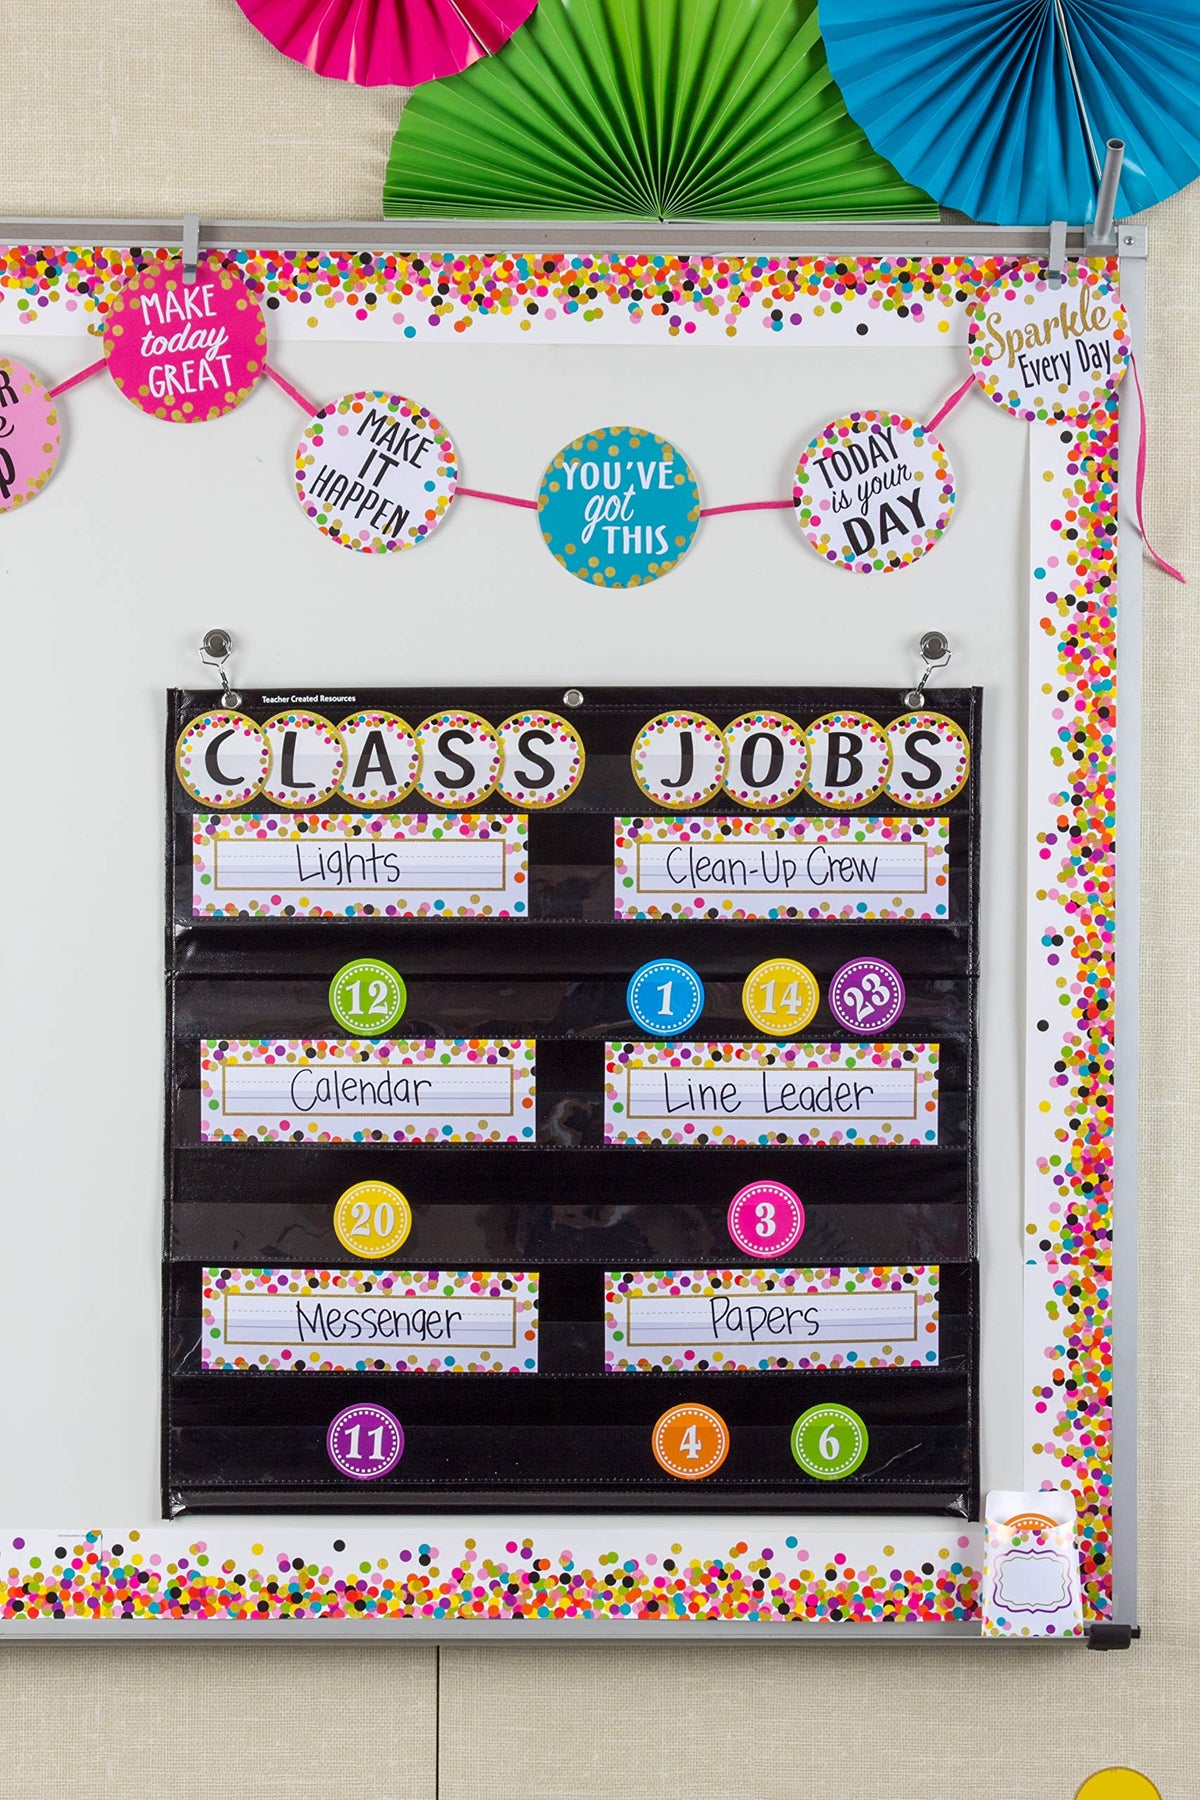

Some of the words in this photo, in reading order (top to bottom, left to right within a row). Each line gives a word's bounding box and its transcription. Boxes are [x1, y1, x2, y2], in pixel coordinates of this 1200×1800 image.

[140, 284, 217, 325] MAKE
[985, 283, 1111, 368] Sparkle
[140, 322, 228, 361] today
[148, 354, 232, 397] GREAT
[1018, 351, 1071, 388] Every
[1075, 339, 1111, 375] Day
[357, 408, 435, 469] MAKE
[813, 427, 898, 489] TODAY
[358, 449, 399, 487] IT
[562, 460, 674, 490] YOU'VE
[309, 464, 410, 539] HAPPEN
[832, 490, 853, 513] is
[858, 464, 912, 516] your
[581, 486, 635, 544] got
[842, 487, 926, 557] DAY
[602, 525, 669, 556] THIS
[262, 695, 289, 704] Teacher
[290, 695, 318, 703] Created
[320, 694, 356, 703] Resources
[296, 842, 401, 885] Lights
[666, 846, 796, 888] Clean-Up
[807, 845, 878, 884] Crew
[345, 980, 389, 1015] 12
[656, 980, 674, 1016] 1
[760, 979, 802, 1016] 14
[843, 972, 891, 1022] 23
[290, 1068, 432, 1112] Calendar
[663, 1072, 742, 1113] Line
[763, 1071, 874, 1114] Leader
[350, 1202, 395, 1237] 20
[755, 1202, 776, 1237] 3
[296, 1300, 462, 1342] Messenger
[709, 1296, 820, 1341] Papers
[345, 1423, 386, 1460] 11
[679, 1424, 702, 1459] 4
[819, 1423, 840, 1460] 6
